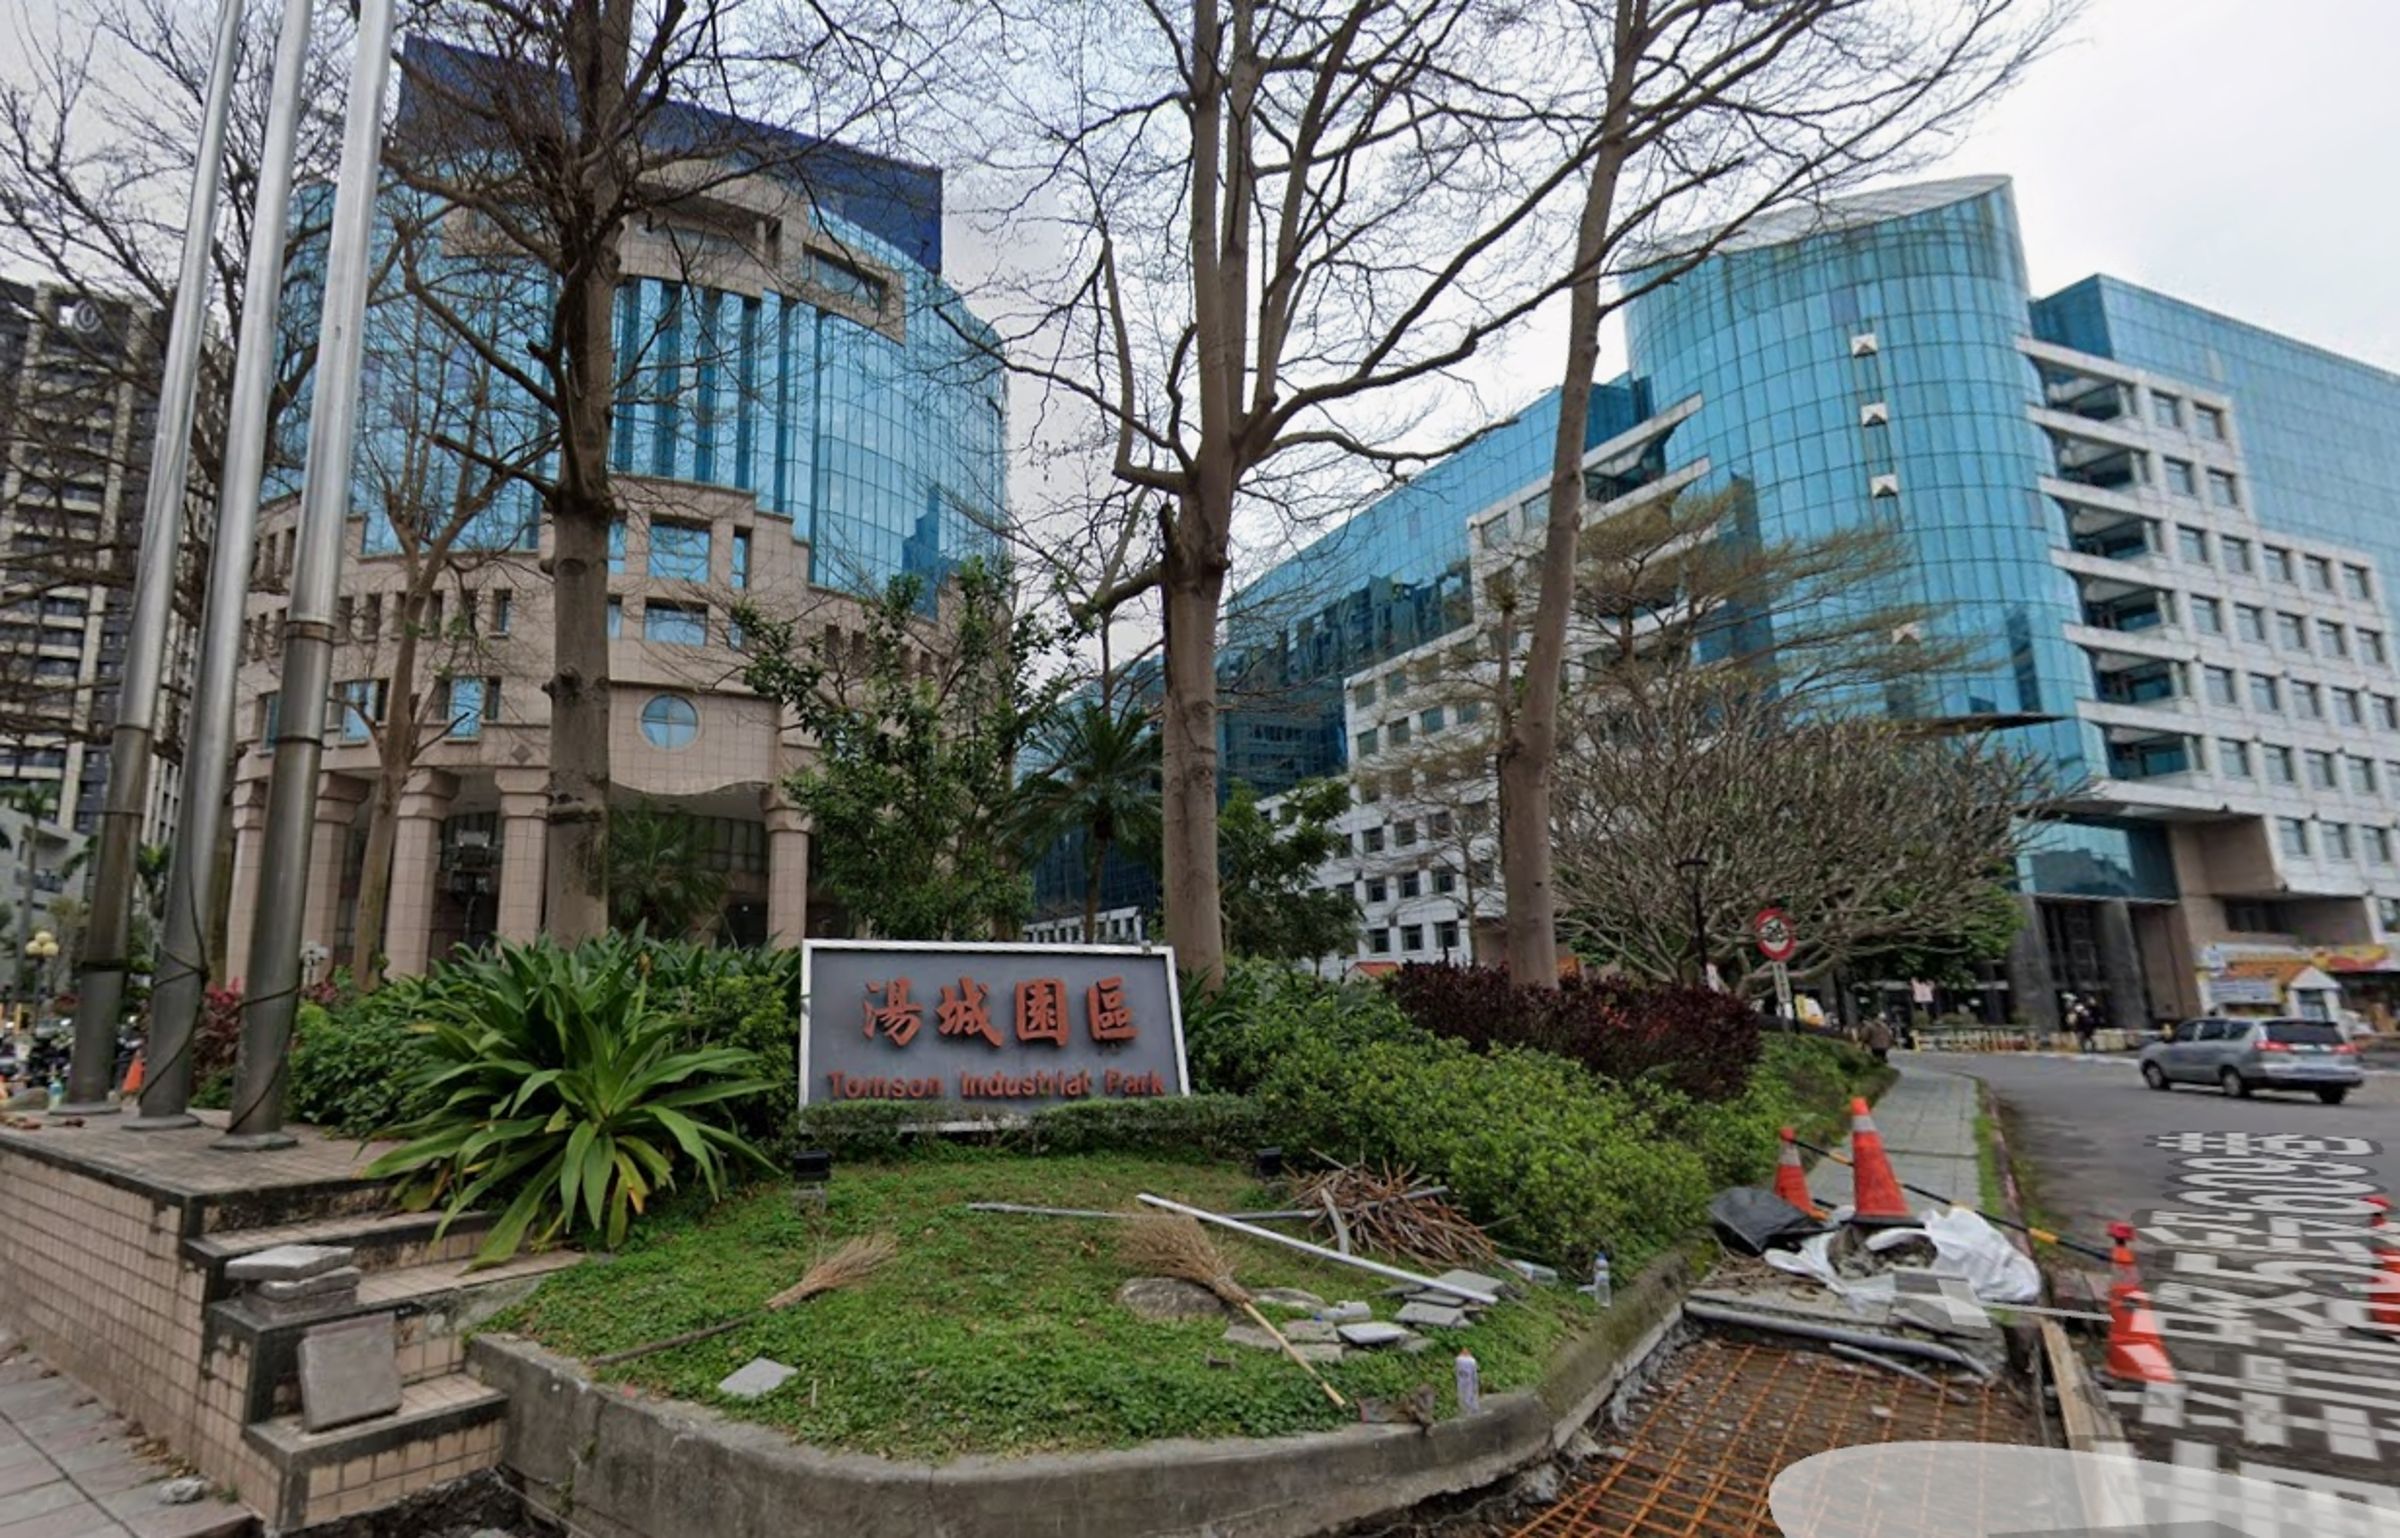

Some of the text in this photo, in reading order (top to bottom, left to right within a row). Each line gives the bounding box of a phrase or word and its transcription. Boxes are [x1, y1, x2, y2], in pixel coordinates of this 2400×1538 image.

[863, 976, 1141, 1047] 湯城園區
[827, 1069, 1166, 1098] Tomson Industrial Park
